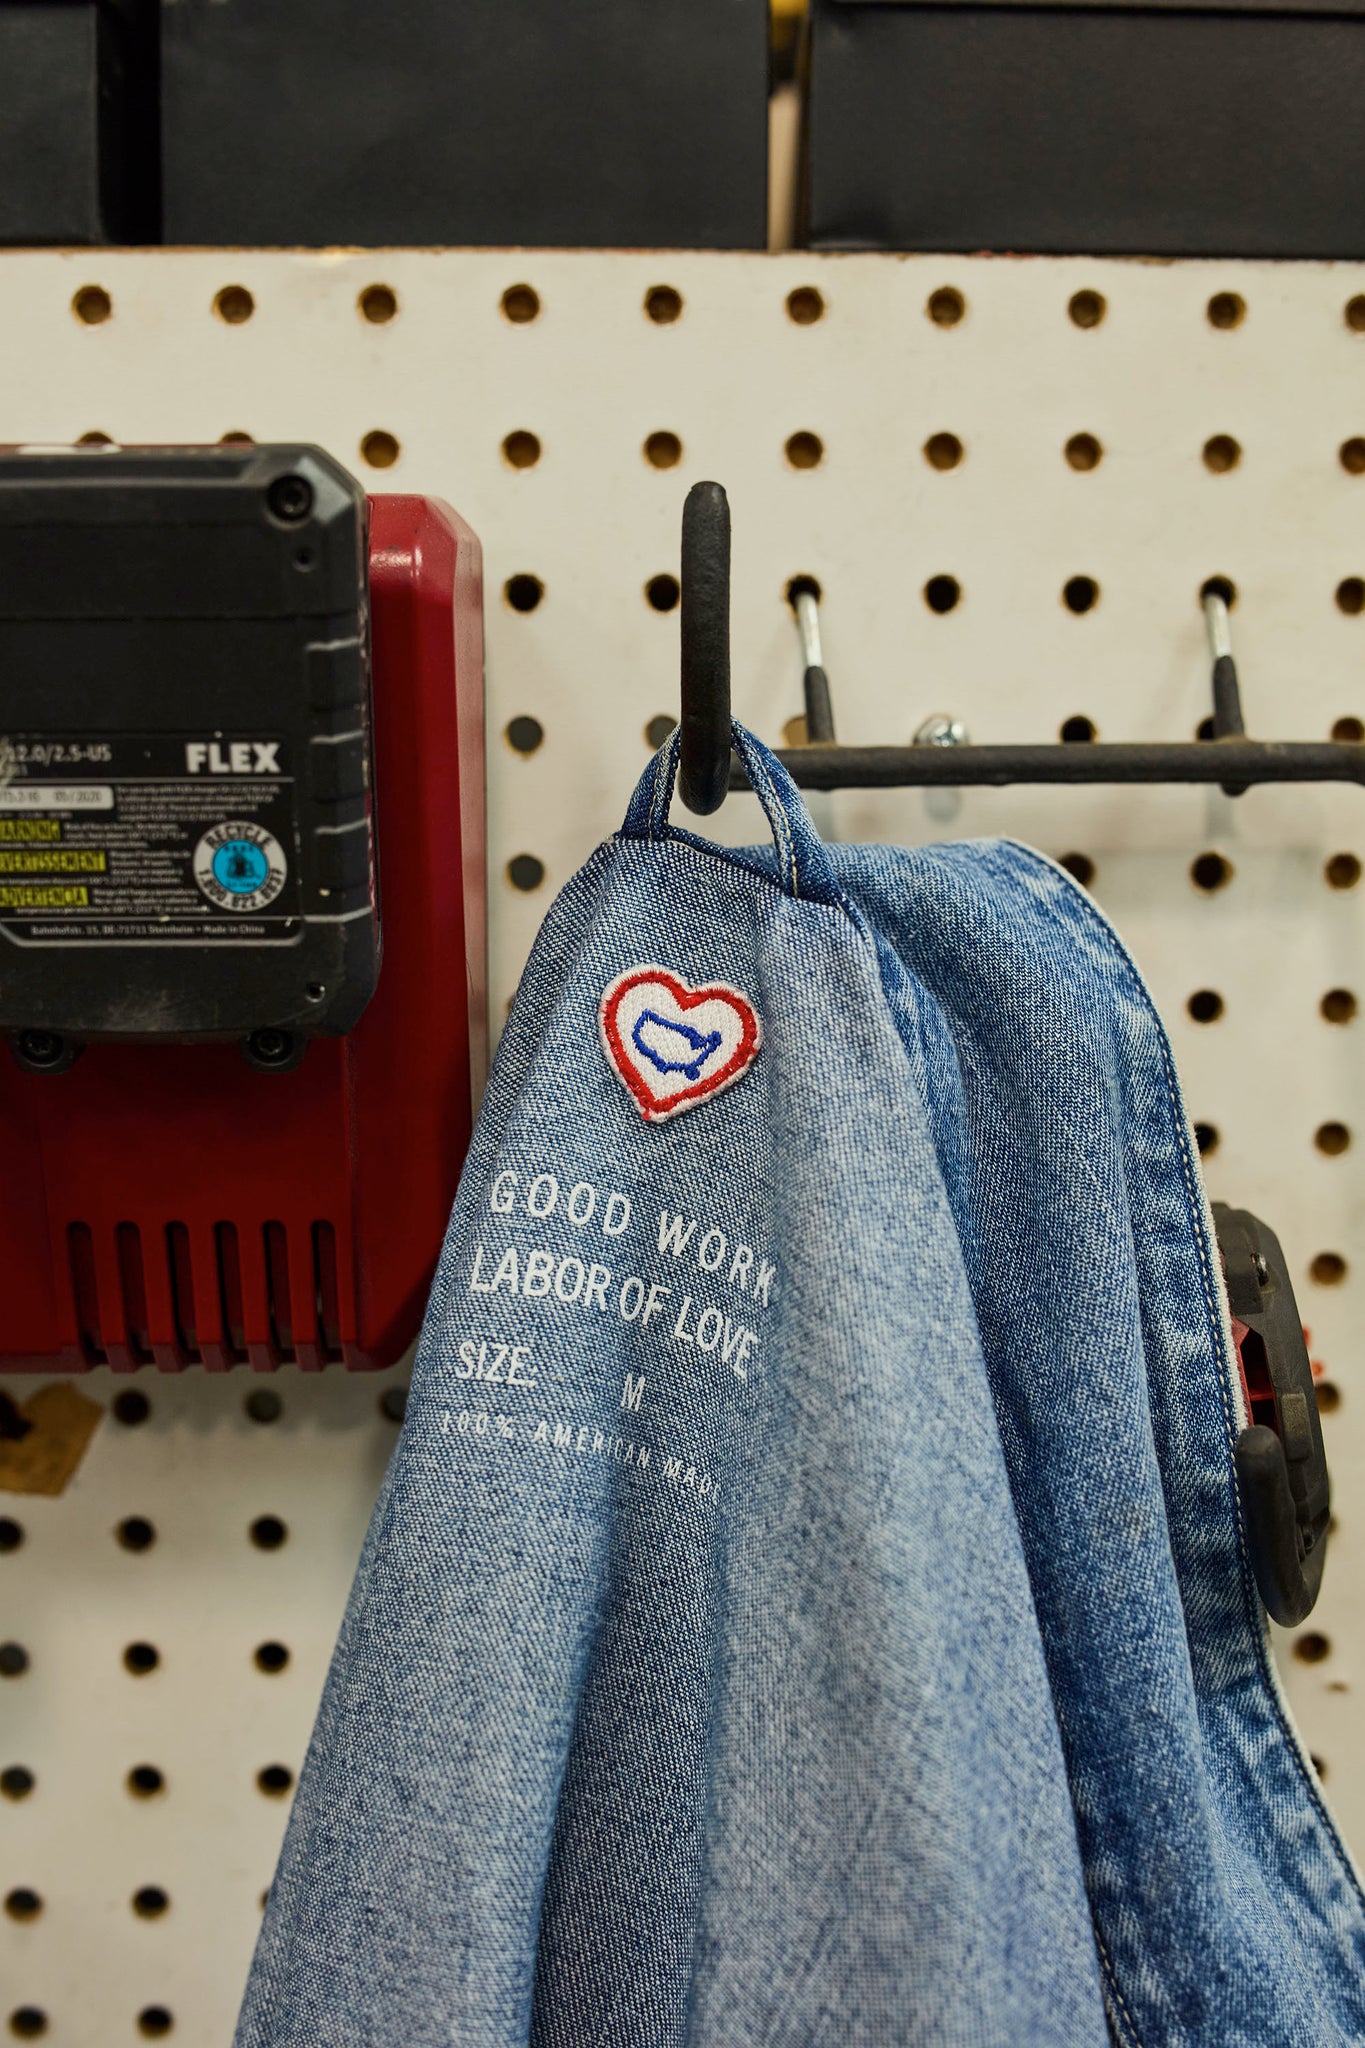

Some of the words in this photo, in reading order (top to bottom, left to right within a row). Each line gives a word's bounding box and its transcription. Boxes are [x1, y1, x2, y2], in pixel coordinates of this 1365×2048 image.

[186, 742, 281, 773] FLEX
[204, 825, 272, 850] RECYCLE
[490, 1170, 631, 1236] GOOD
[658, 1210, 777, 1308] WORK
[469, 1249, 612, 1312] LABOR
[619, 1276, 673, 1326] OF
[674, 1295, 759, 1380] LOVE
[620, 1372, 646, 1413] M
[440, 1408, 516, 1440] 100%
[533, 1419, 651, 1469] AMERICAN
